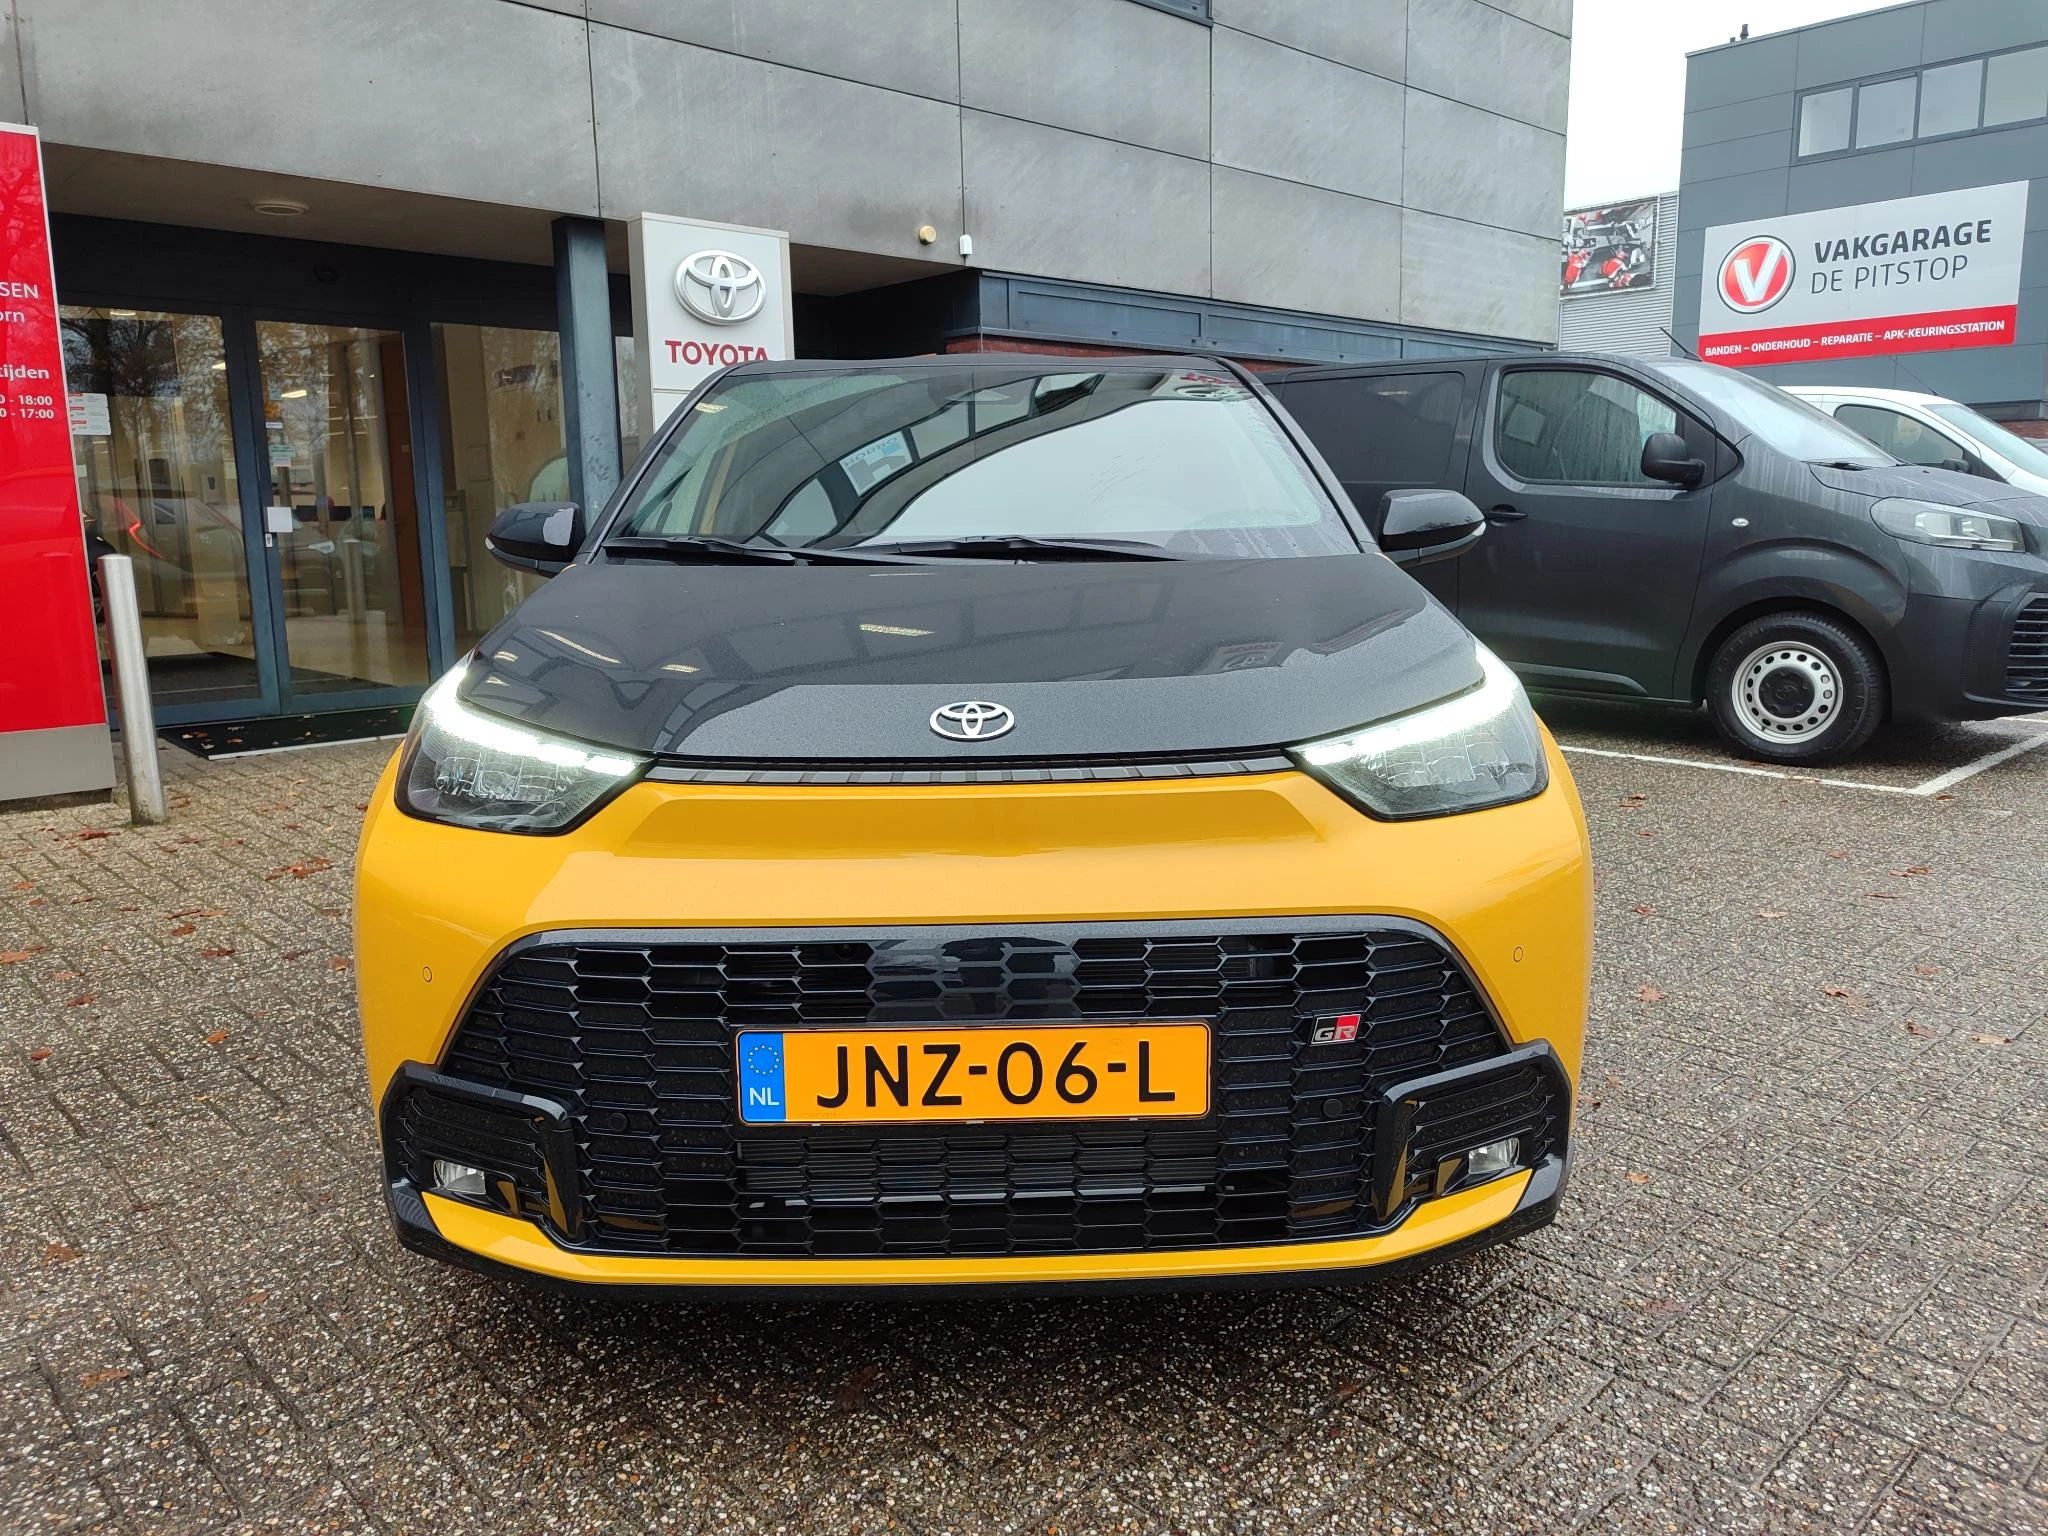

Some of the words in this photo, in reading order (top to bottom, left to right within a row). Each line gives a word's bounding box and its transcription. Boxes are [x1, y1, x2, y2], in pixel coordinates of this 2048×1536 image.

[1814, 219, 1992, 264] VAKGARAGE
[1811, 270, 1843, 294] DE
[1854, 254, 1968, 290] PITSTOP
[664, 339, 769, 368] TOYOTA
[1705, 344, 1742, 357] BANDEN
[1751, 338, 1811, 352] ONDERHOUD
[1821, 332, 1873, 346] REPARATIE
[1883, 320, 2005, 341] APK-KEURINGSSTATION
[18, 394, 53, 406] 18:00
[19, 408, 54, 419] 17:00
[1314, 1025, 1356, 1041] GR
[749, 1087, 780, 1106] NL
[816, 1040, 1176, 1109] JNZ-06-L
